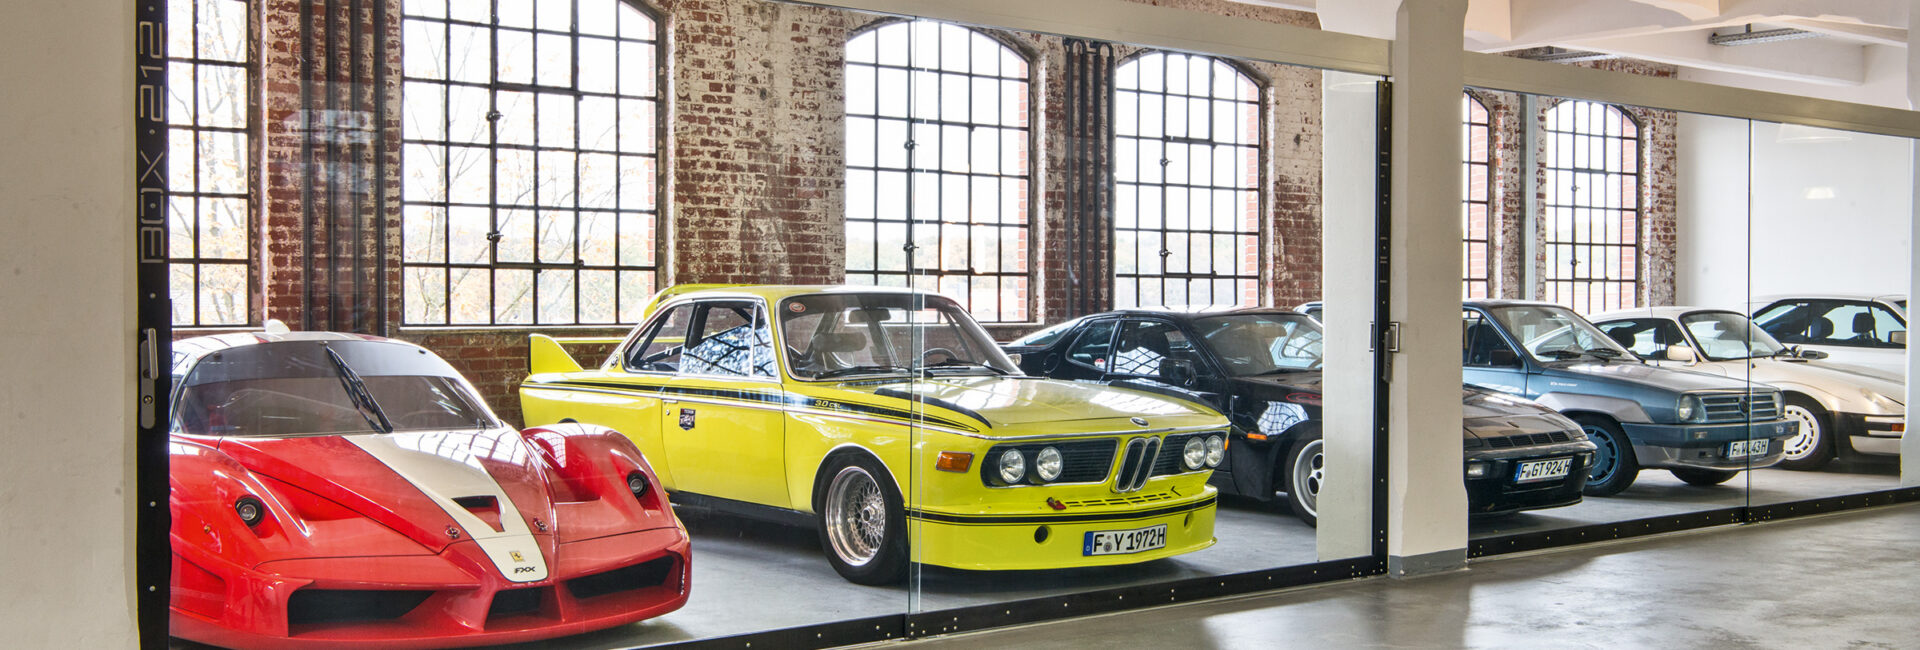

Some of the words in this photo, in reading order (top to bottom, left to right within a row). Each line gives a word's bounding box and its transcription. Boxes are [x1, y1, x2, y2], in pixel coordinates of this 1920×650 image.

[139, 21, 164, 122] 212
[140, 150, 164, 263] BOX
[514, 566, 536, 574] FXX
